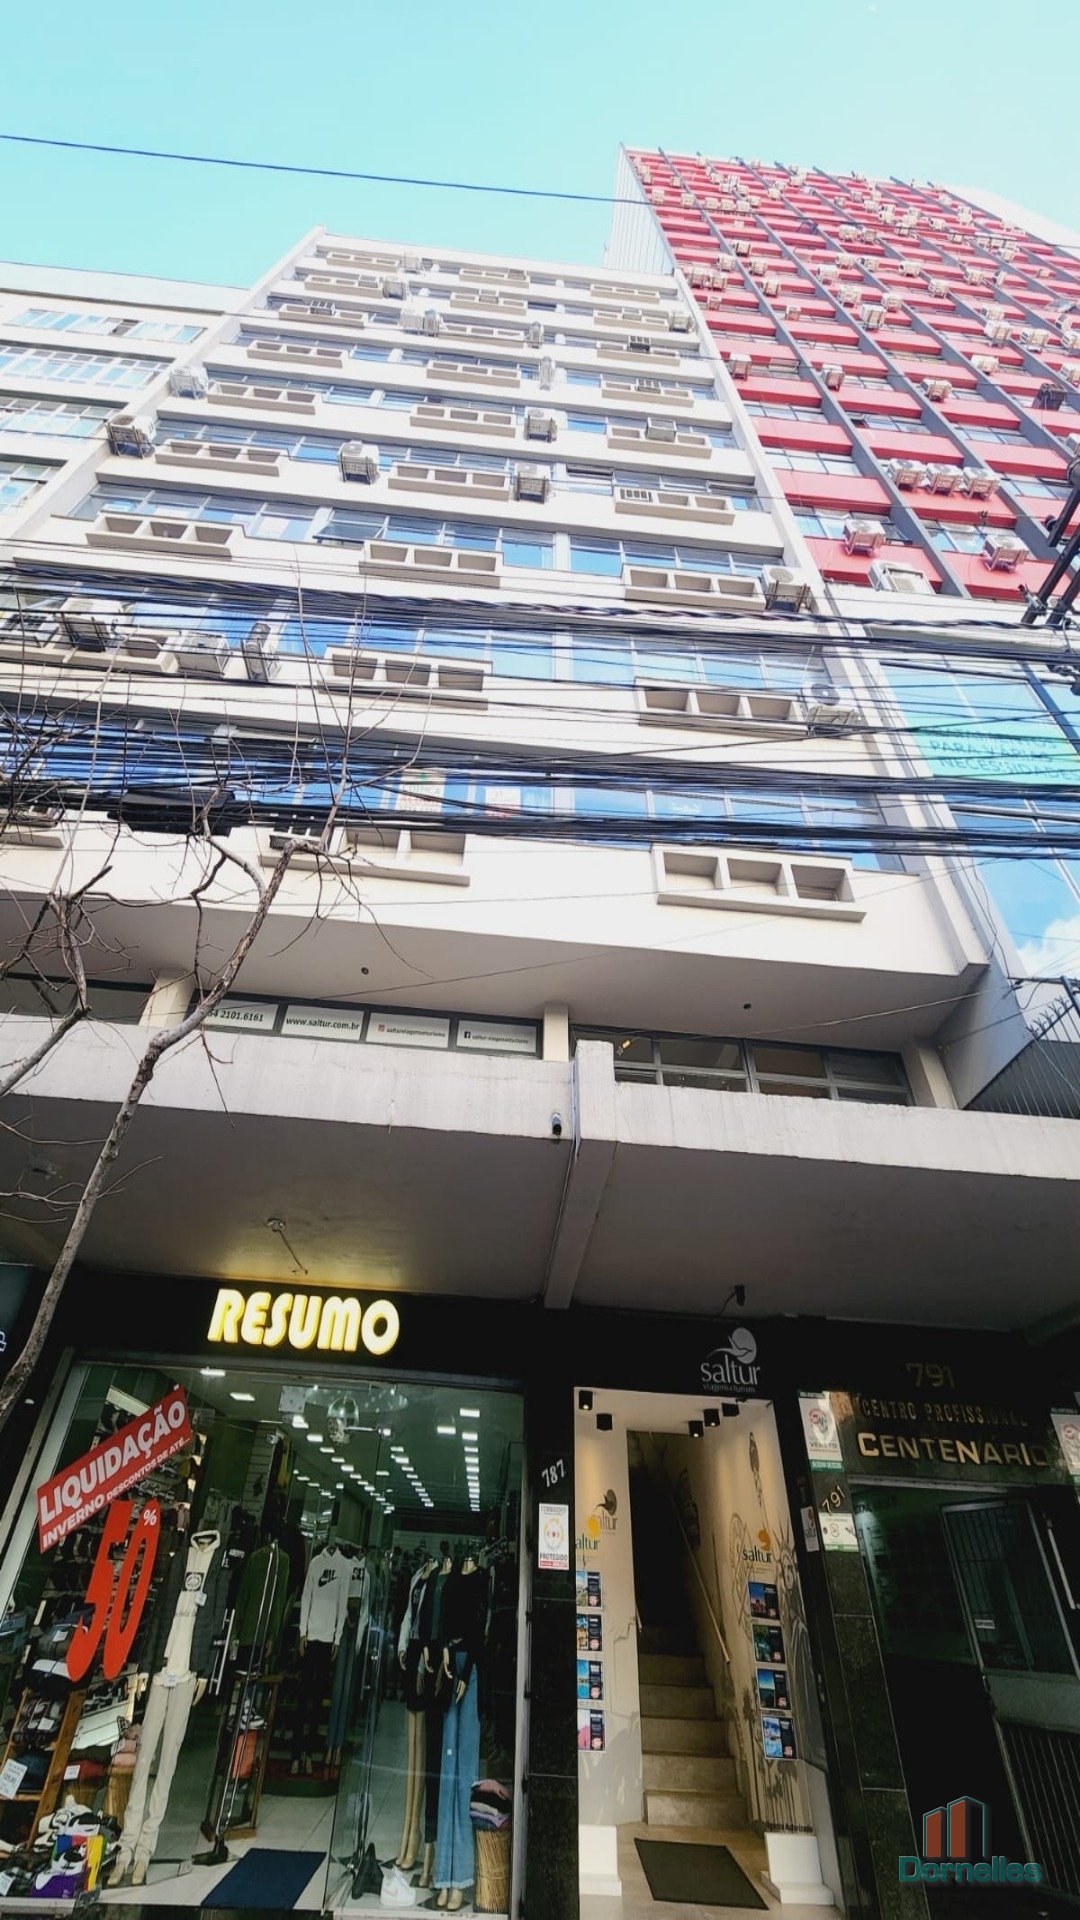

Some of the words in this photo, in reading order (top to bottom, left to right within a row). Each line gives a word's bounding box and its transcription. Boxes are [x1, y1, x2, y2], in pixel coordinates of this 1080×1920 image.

[220, 1010, 264, 1022] 2101.6161
[286, 1017, 360, 1030] www.saltur.com.br
[207, 1288, 400, 1355] RESUMO
[700, 1354, 761, 1385] saltur
[905, 1362, 956, 1389] 791
[861, 1398, 917, 1421] CENTRO
[39, 1401, 186, 1526] LIQUIDAÇÃO
[541, 1459, 565, 1488] 787
[43, 1493, 105, 1550] INVERNO
[107, 1456, 156, 1500] DESCONTOS
[156, 1450, 169, 1464] DE
[821, 1485, 846, 1516] 791
[575, 1533, 600, 1550] altur
[742, 1545, 772, 1563] saltur
